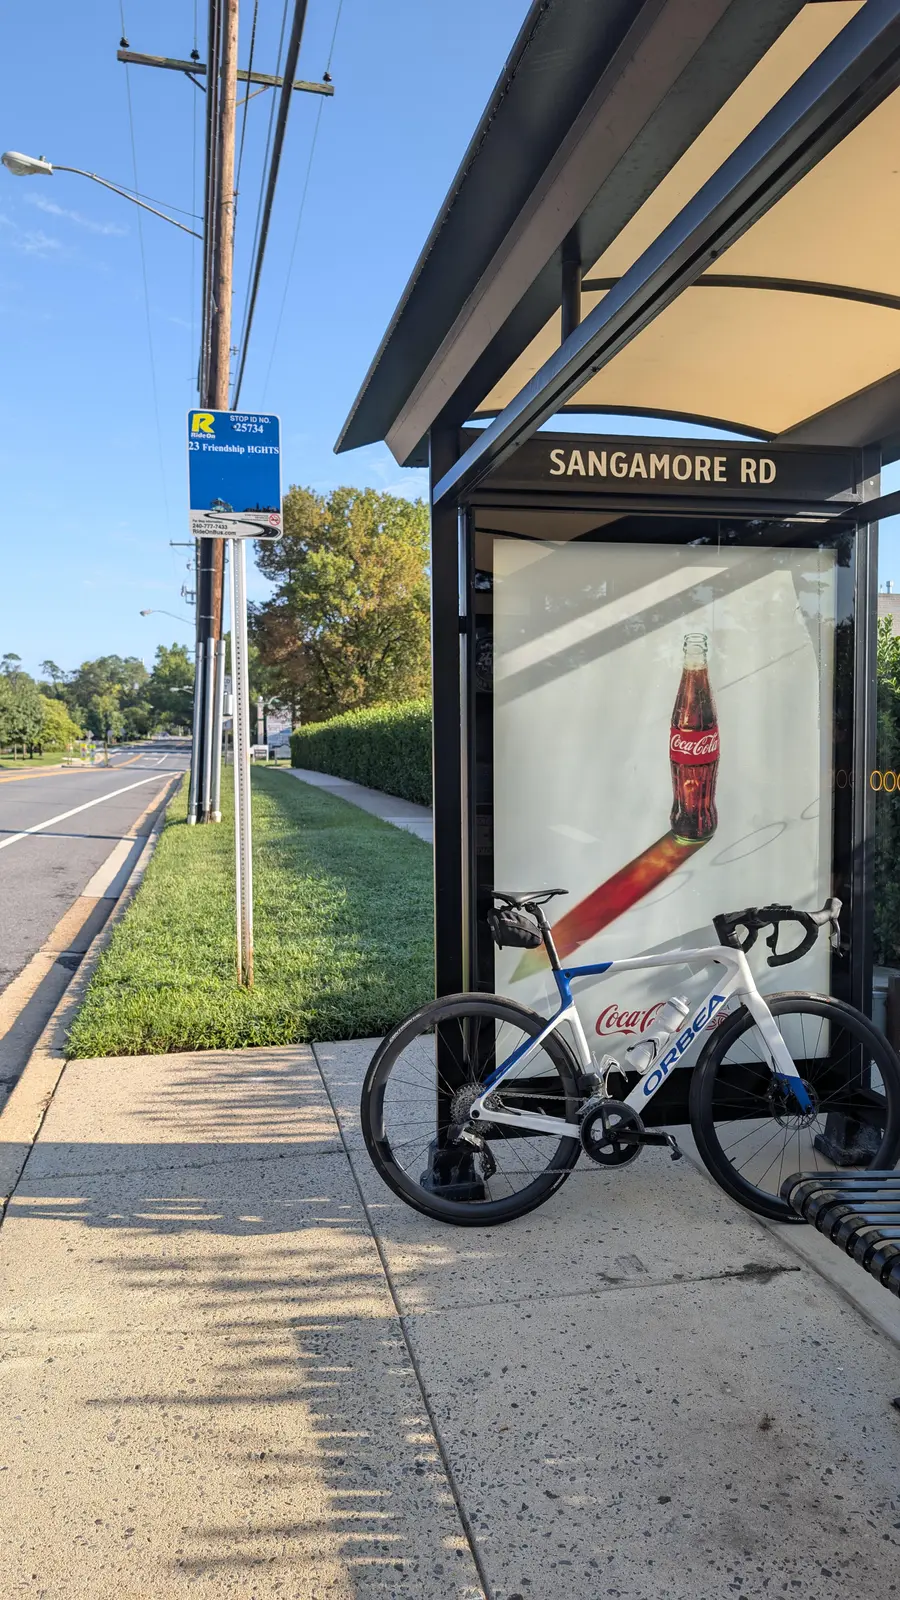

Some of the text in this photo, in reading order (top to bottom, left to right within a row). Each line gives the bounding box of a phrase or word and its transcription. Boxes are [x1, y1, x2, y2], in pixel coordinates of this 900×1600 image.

[235, 423, 264, 433] 25734
[189, 441, 280, 455] 23 Friendship HGHTS
[549, 449, 777, 484] SANGAMORE RD
[670, 731, 719, 756] Coca-Cola
[643, 994, 727, 1097] ORBEA
